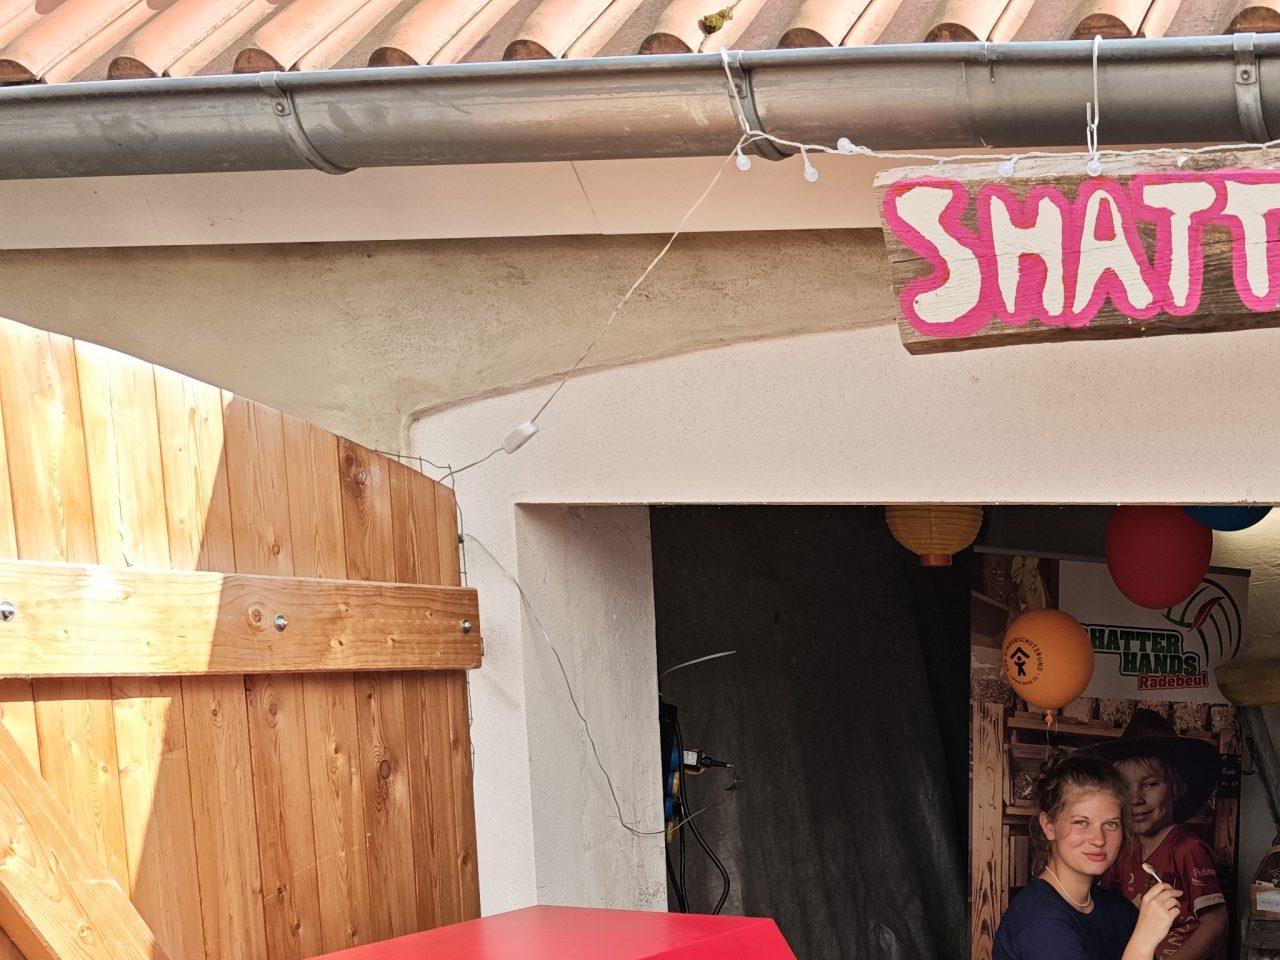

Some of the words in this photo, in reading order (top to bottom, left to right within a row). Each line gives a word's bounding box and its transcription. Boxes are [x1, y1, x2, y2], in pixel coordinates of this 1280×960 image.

[1085, 627, 1181, 654] HATTER
[1122, 652, 1198, 675] HANDS
[1138, 672, 1208, 689] Radebeul
